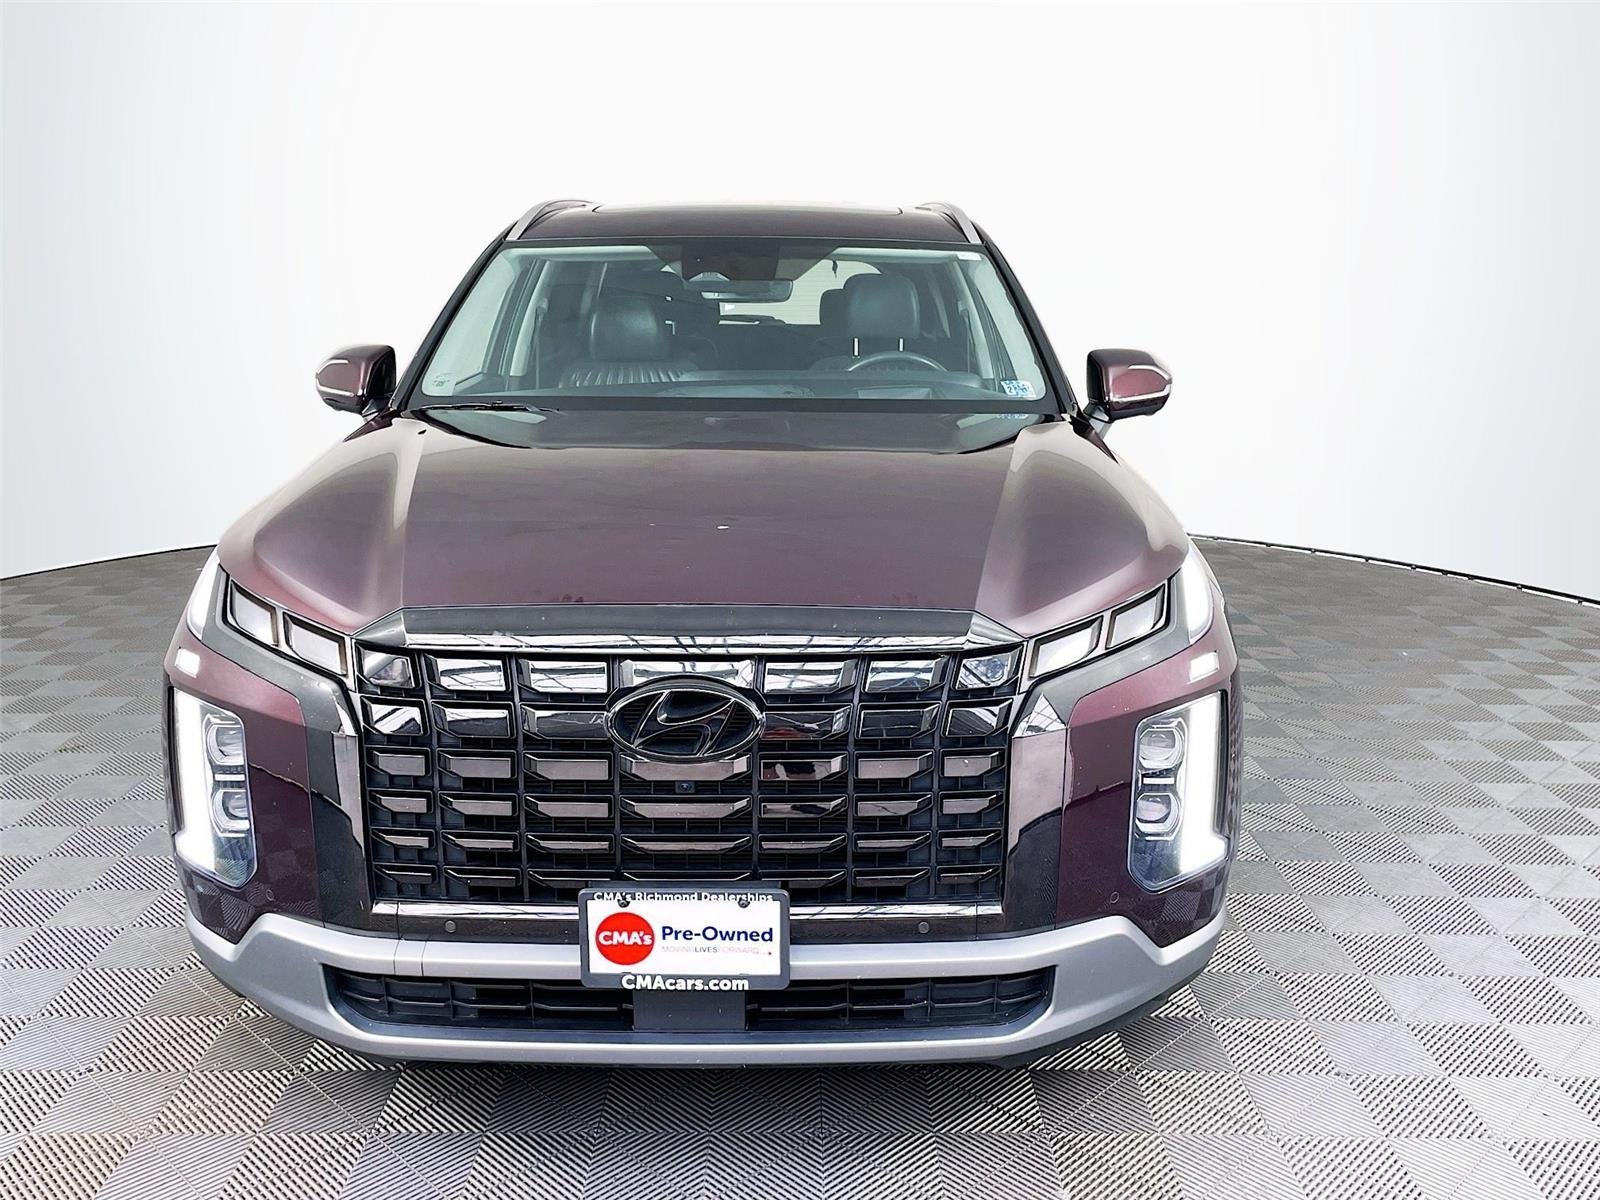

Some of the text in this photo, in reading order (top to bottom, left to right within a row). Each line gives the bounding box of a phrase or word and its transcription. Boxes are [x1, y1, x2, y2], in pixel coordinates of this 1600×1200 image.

[593, 892, 773, 902] CMA's Richmond Dealerships
[598, 931, 653, 946] CMA's
[662, 926, 773, 942] Pre-Owned
[621, 974, 749, 990] CMAcars.com
